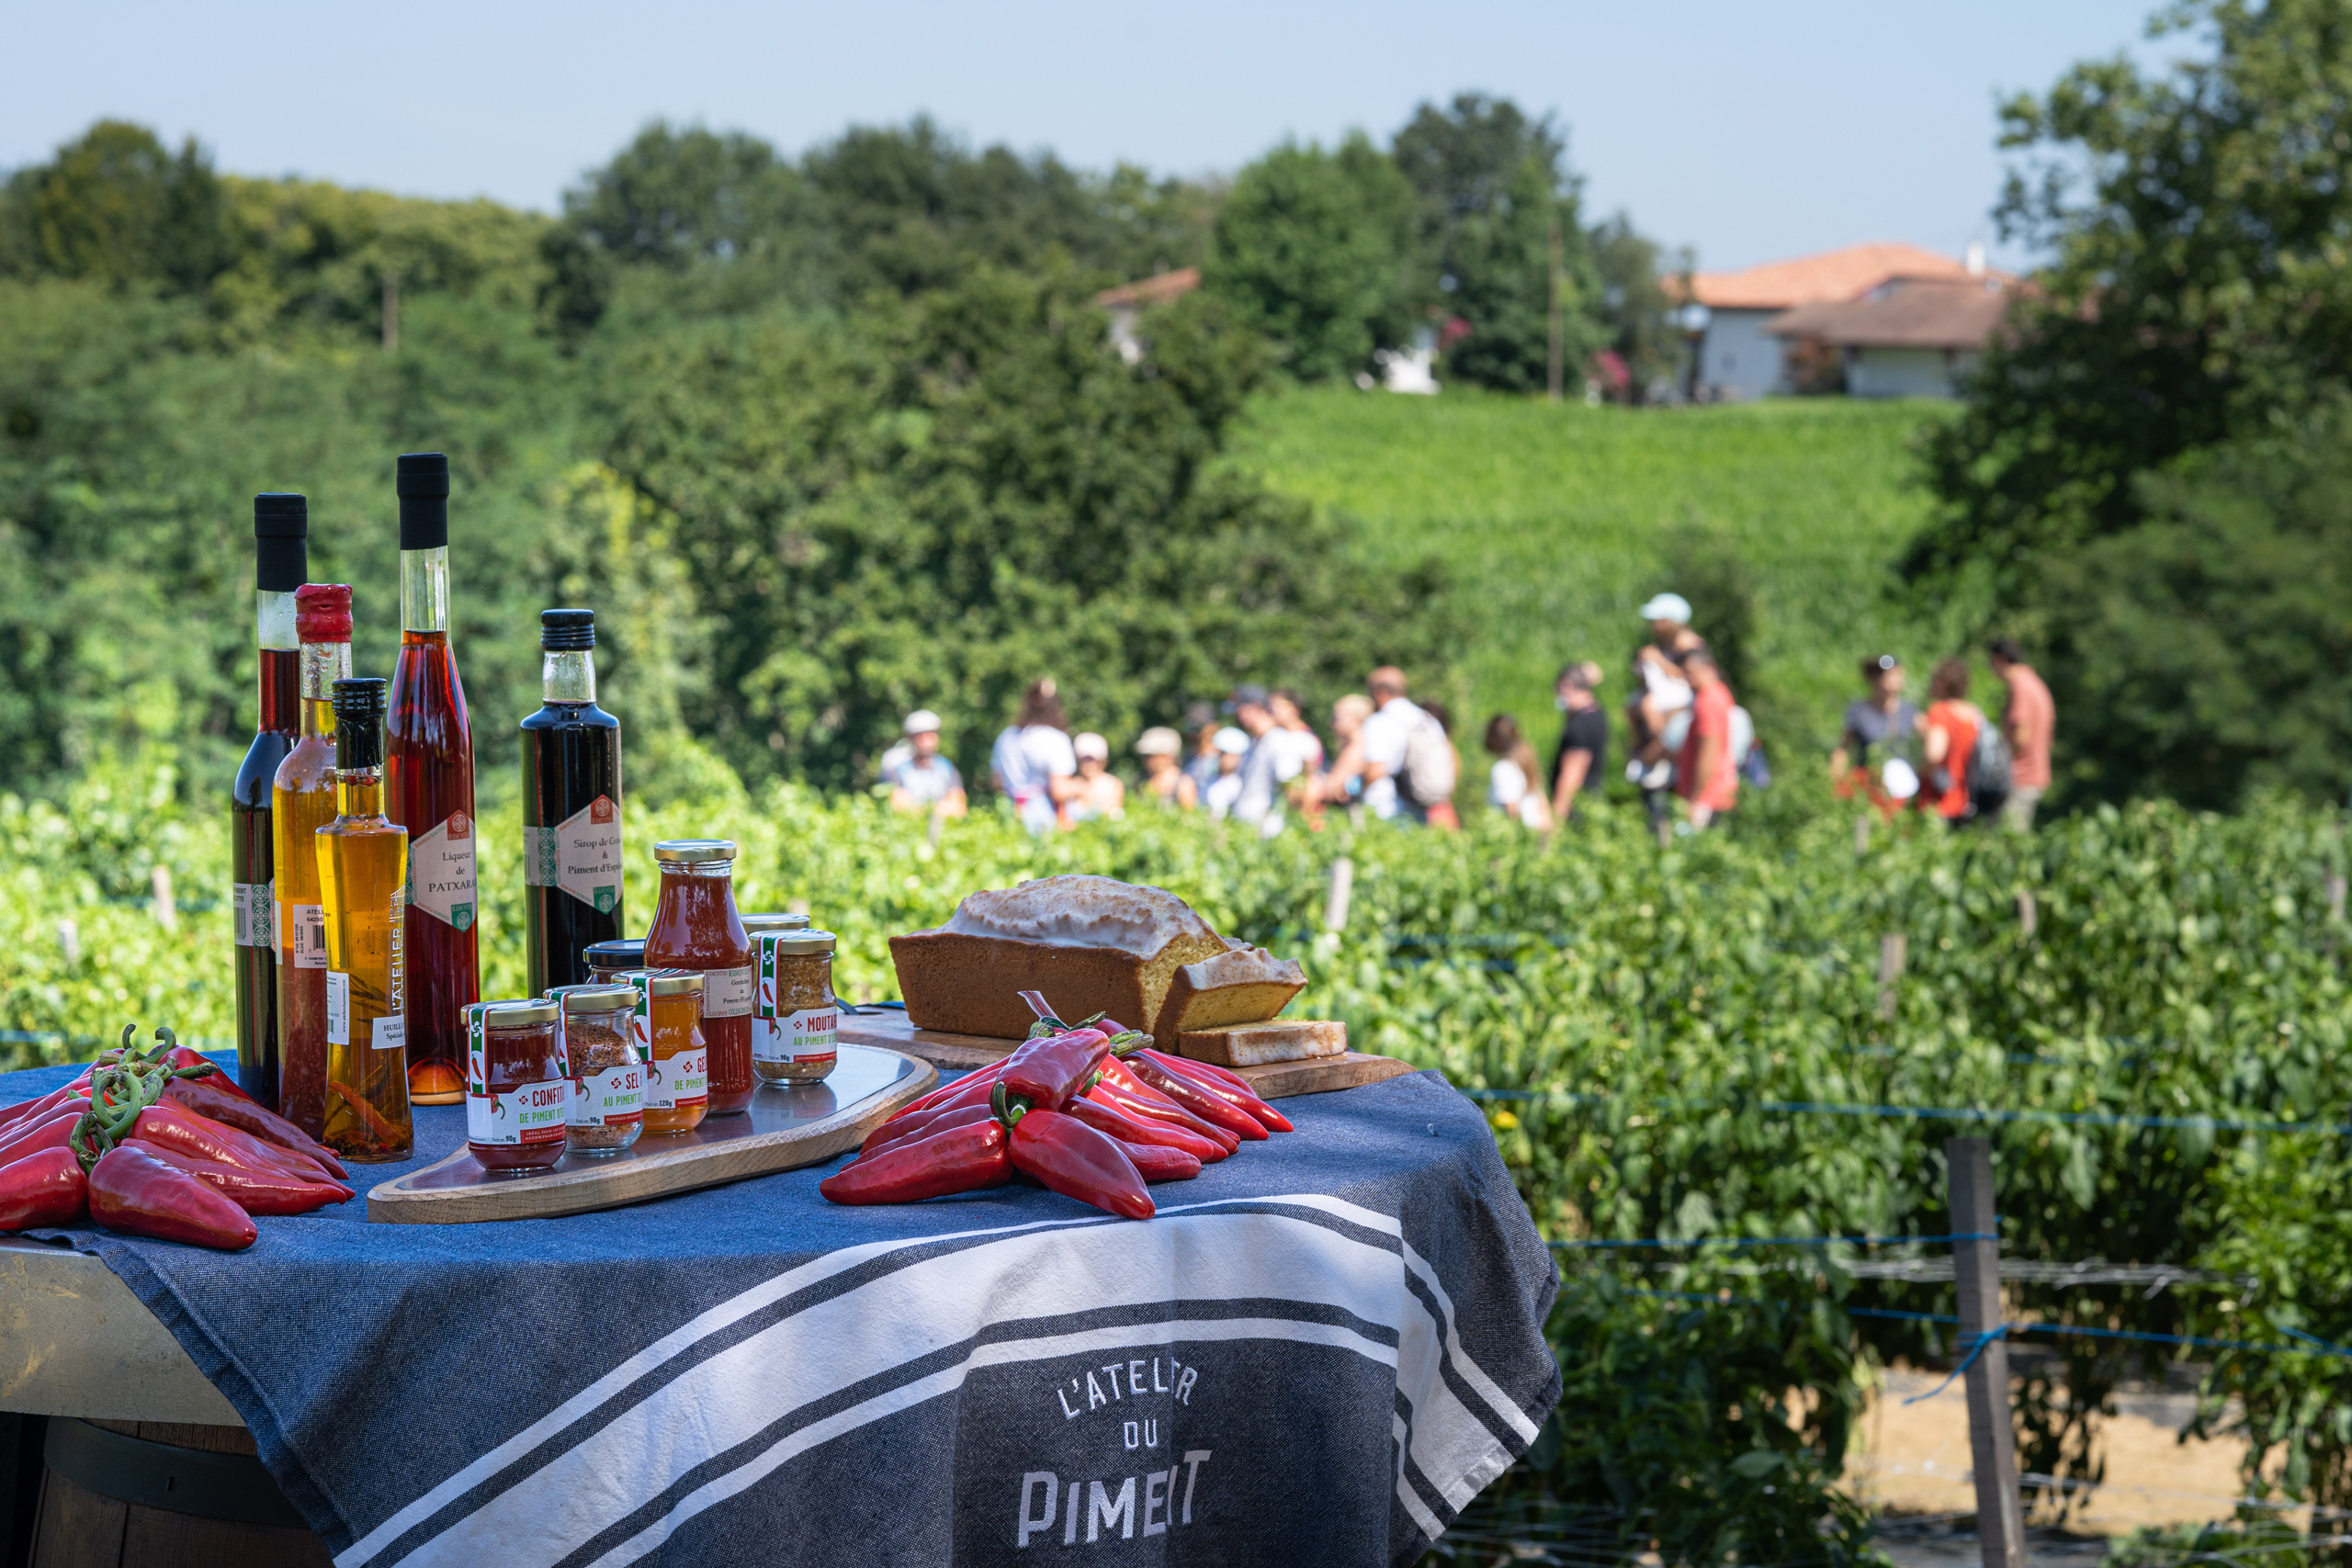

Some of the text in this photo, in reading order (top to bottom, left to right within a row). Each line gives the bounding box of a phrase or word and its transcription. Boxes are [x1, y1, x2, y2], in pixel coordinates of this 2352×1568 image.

[573, 839, 597, 850] Sirop
[599, 838, 608, 846] de
[443, 851, 470, 863] Liqueur
[602, 851, 608, 859] &
[456, 866, 465, 874] de
[568, 864, 598, 874] Piment
[392, 928, 401, 1010] L'ATELIER
[383, 1023, 401, 1032] HUILE
[793, 1036, 803, 1046] AU
[805, 1034, 827, 1046] PIMENT
[780, 1054, 789, 1062] 90g
[626, 1072, 639, 1090] SEL
[674, 1080, 684, 1090] DE
[685, 1077, 704, 1089] PIMENT
[604, 1097, 613, 1107] AU
[616, 1093, 637, 1106] PIMENT
[519, 1112, 529, 1123] DE
[532, 1108, 555, 1122] PIMENT
[1124, 1419, 1158, 1450] DU
